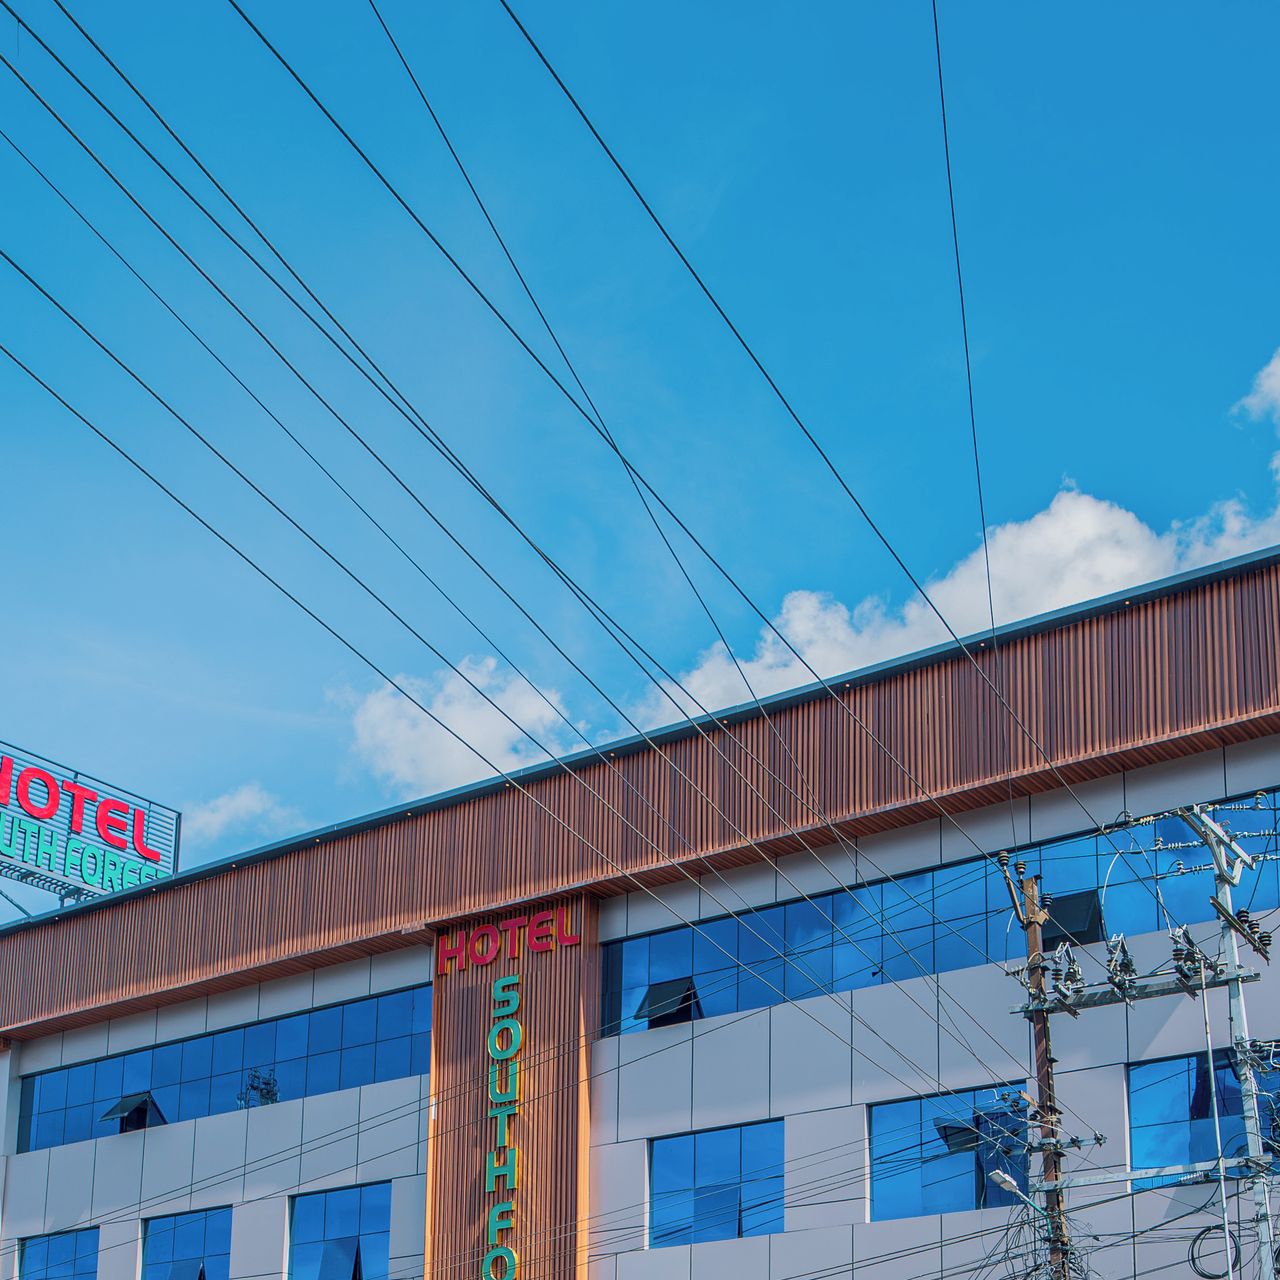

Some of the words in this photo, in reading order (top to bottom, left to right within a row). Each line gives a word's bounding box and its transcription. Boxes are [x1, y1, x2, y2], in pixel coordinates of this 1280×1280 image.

[63, 838, 170, 893] FORES
[438, 906, 580, 975] HOTEL
[486, 973, 523, 1192] SOUTH
